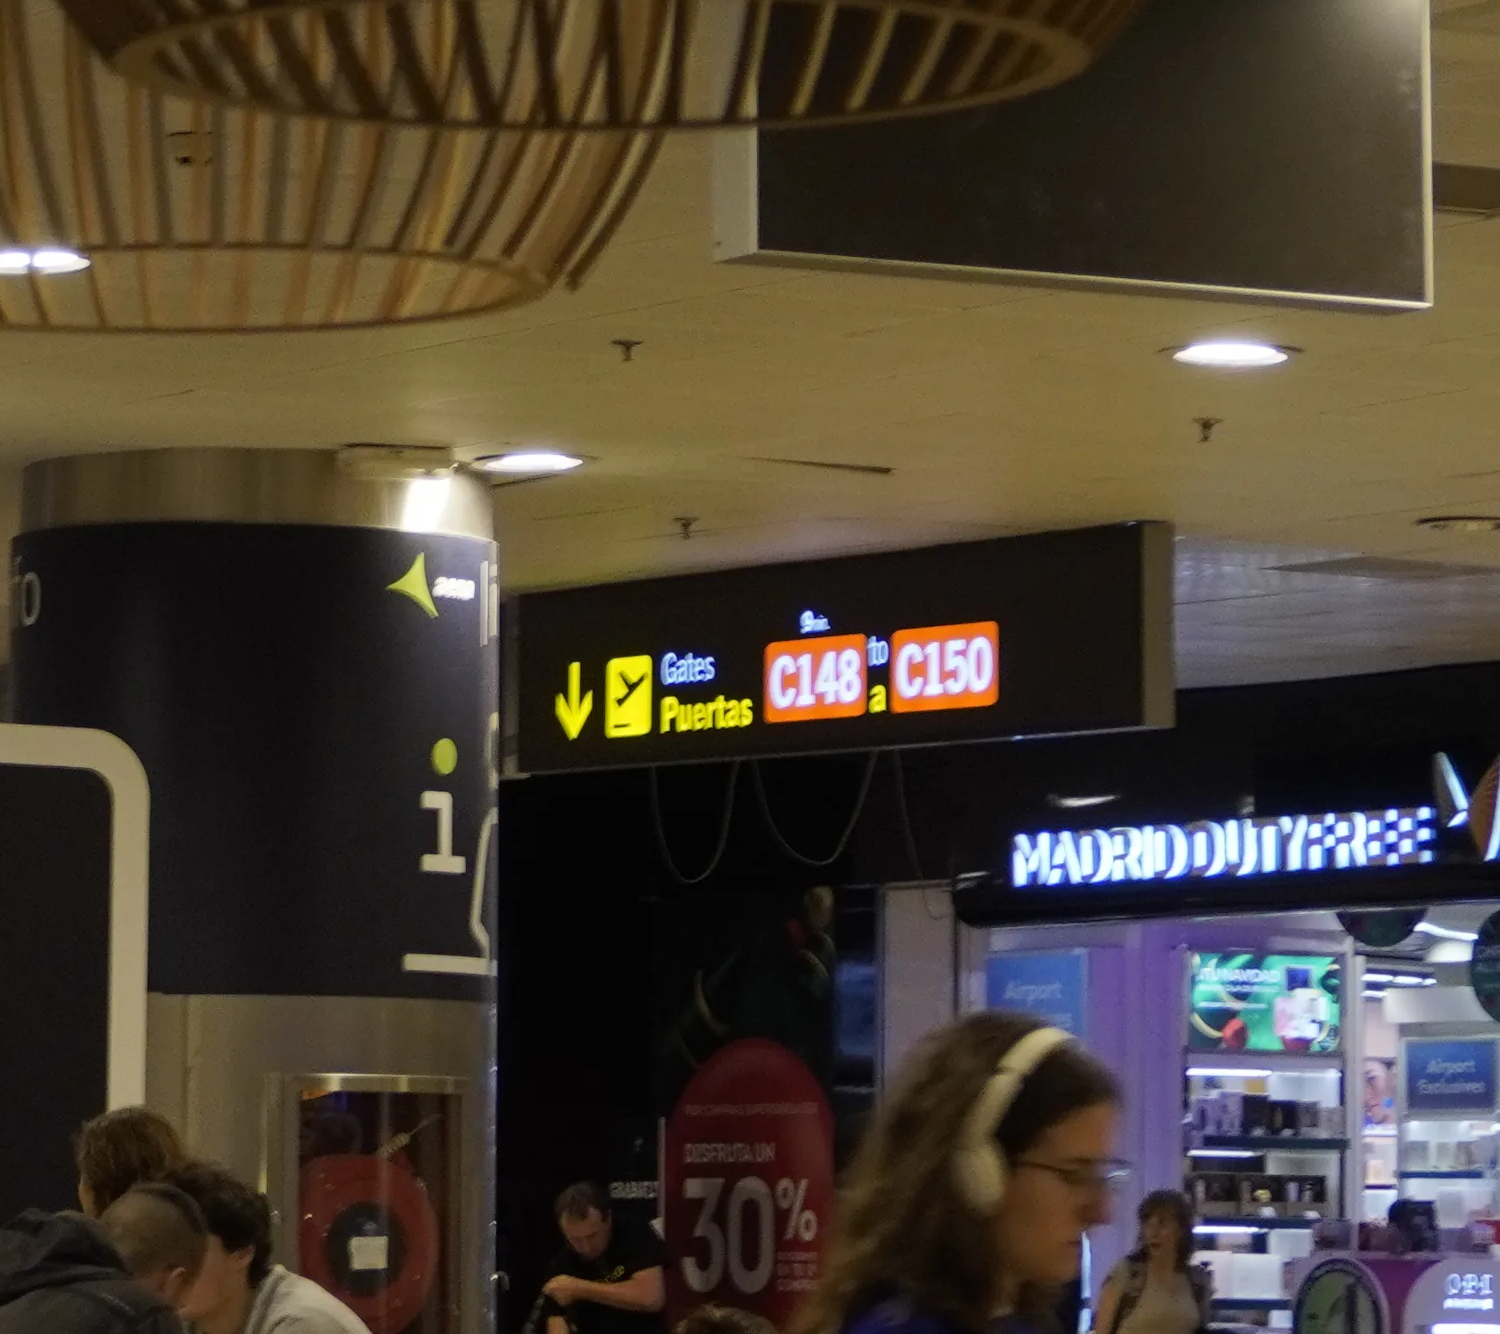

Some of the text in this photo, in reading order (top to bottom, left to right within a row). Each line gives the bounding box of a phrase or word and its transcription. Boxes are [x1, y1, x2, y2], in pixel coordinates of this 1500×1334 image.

[660, 651, 717, 687] Gates
[768, 634, 993, 710] C148 to C150
[869, 683, 887, 714] a
[659, 693, 754, 735] Puertas
[1010, 824, 1188, 889] MADRID
[1190, 811, 1308, 880] DUTY
[680, 1175, 819, 1295] 30%
